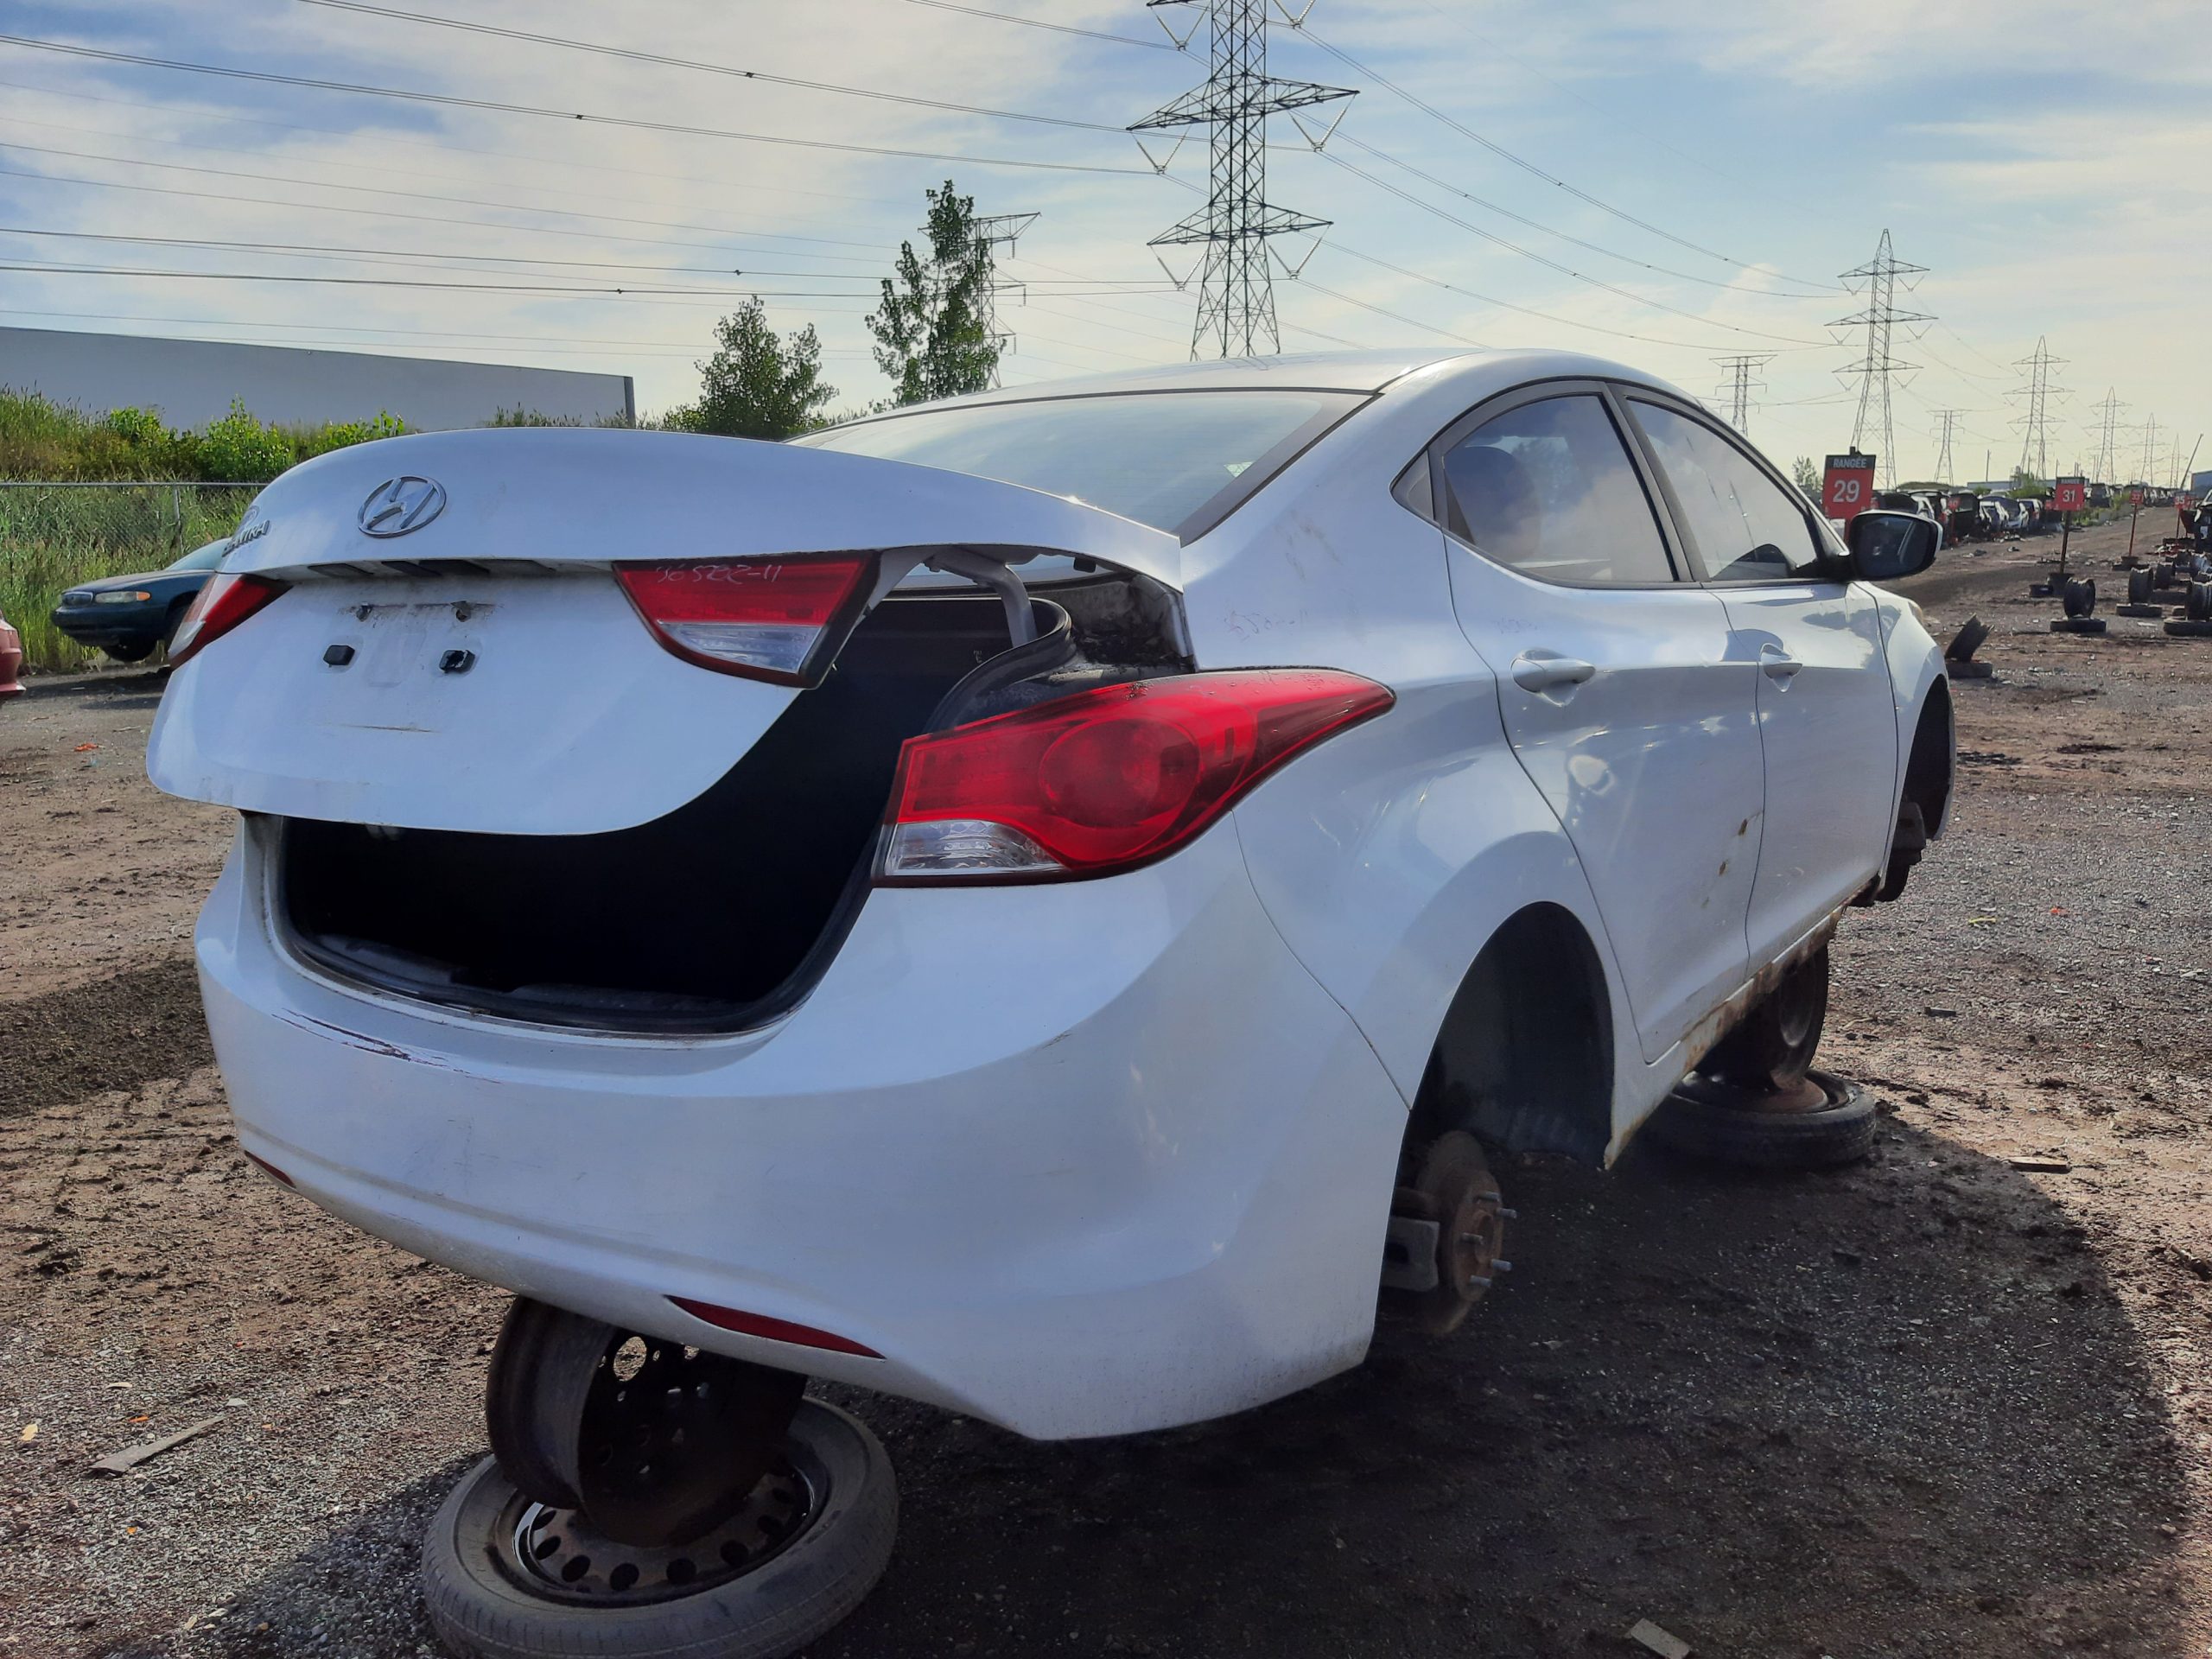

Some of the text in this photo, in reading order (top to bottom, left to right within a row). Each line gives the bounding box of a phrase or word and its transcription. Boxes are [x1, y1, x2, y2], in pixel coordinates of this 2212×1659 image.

[1833, 457, 1867, 468] RANGÉE
[1833, 480, 1860, 503] 29
[2063, 489, 2075, 503] 31
